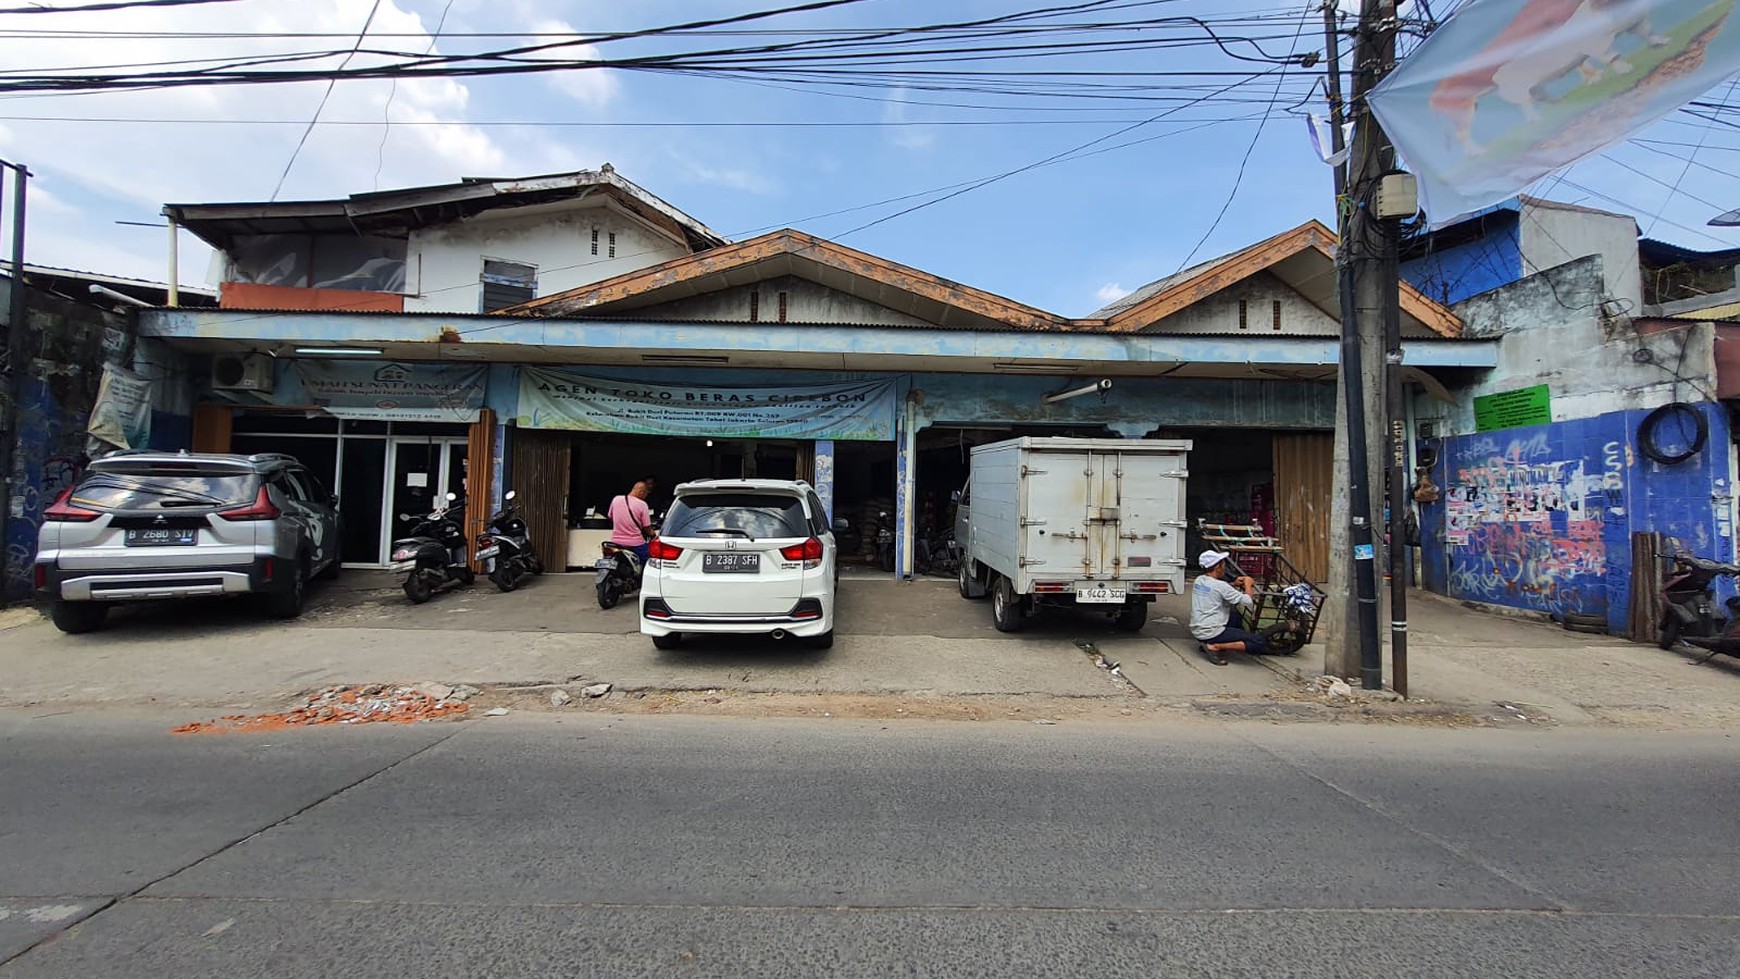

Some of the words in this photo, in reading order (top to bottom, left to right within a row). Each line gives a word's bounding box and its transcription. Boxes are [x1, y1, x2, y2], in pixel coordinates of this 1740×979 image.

[538, 383, 597, 395] AGEN
[611, 388, 672, 400] TOKO
[685, 393, 754, 402] BERAS
[128, 529, 136, 539] B
[705, 555, 712, 565] B
[742, 555, 758, 565] SFH
